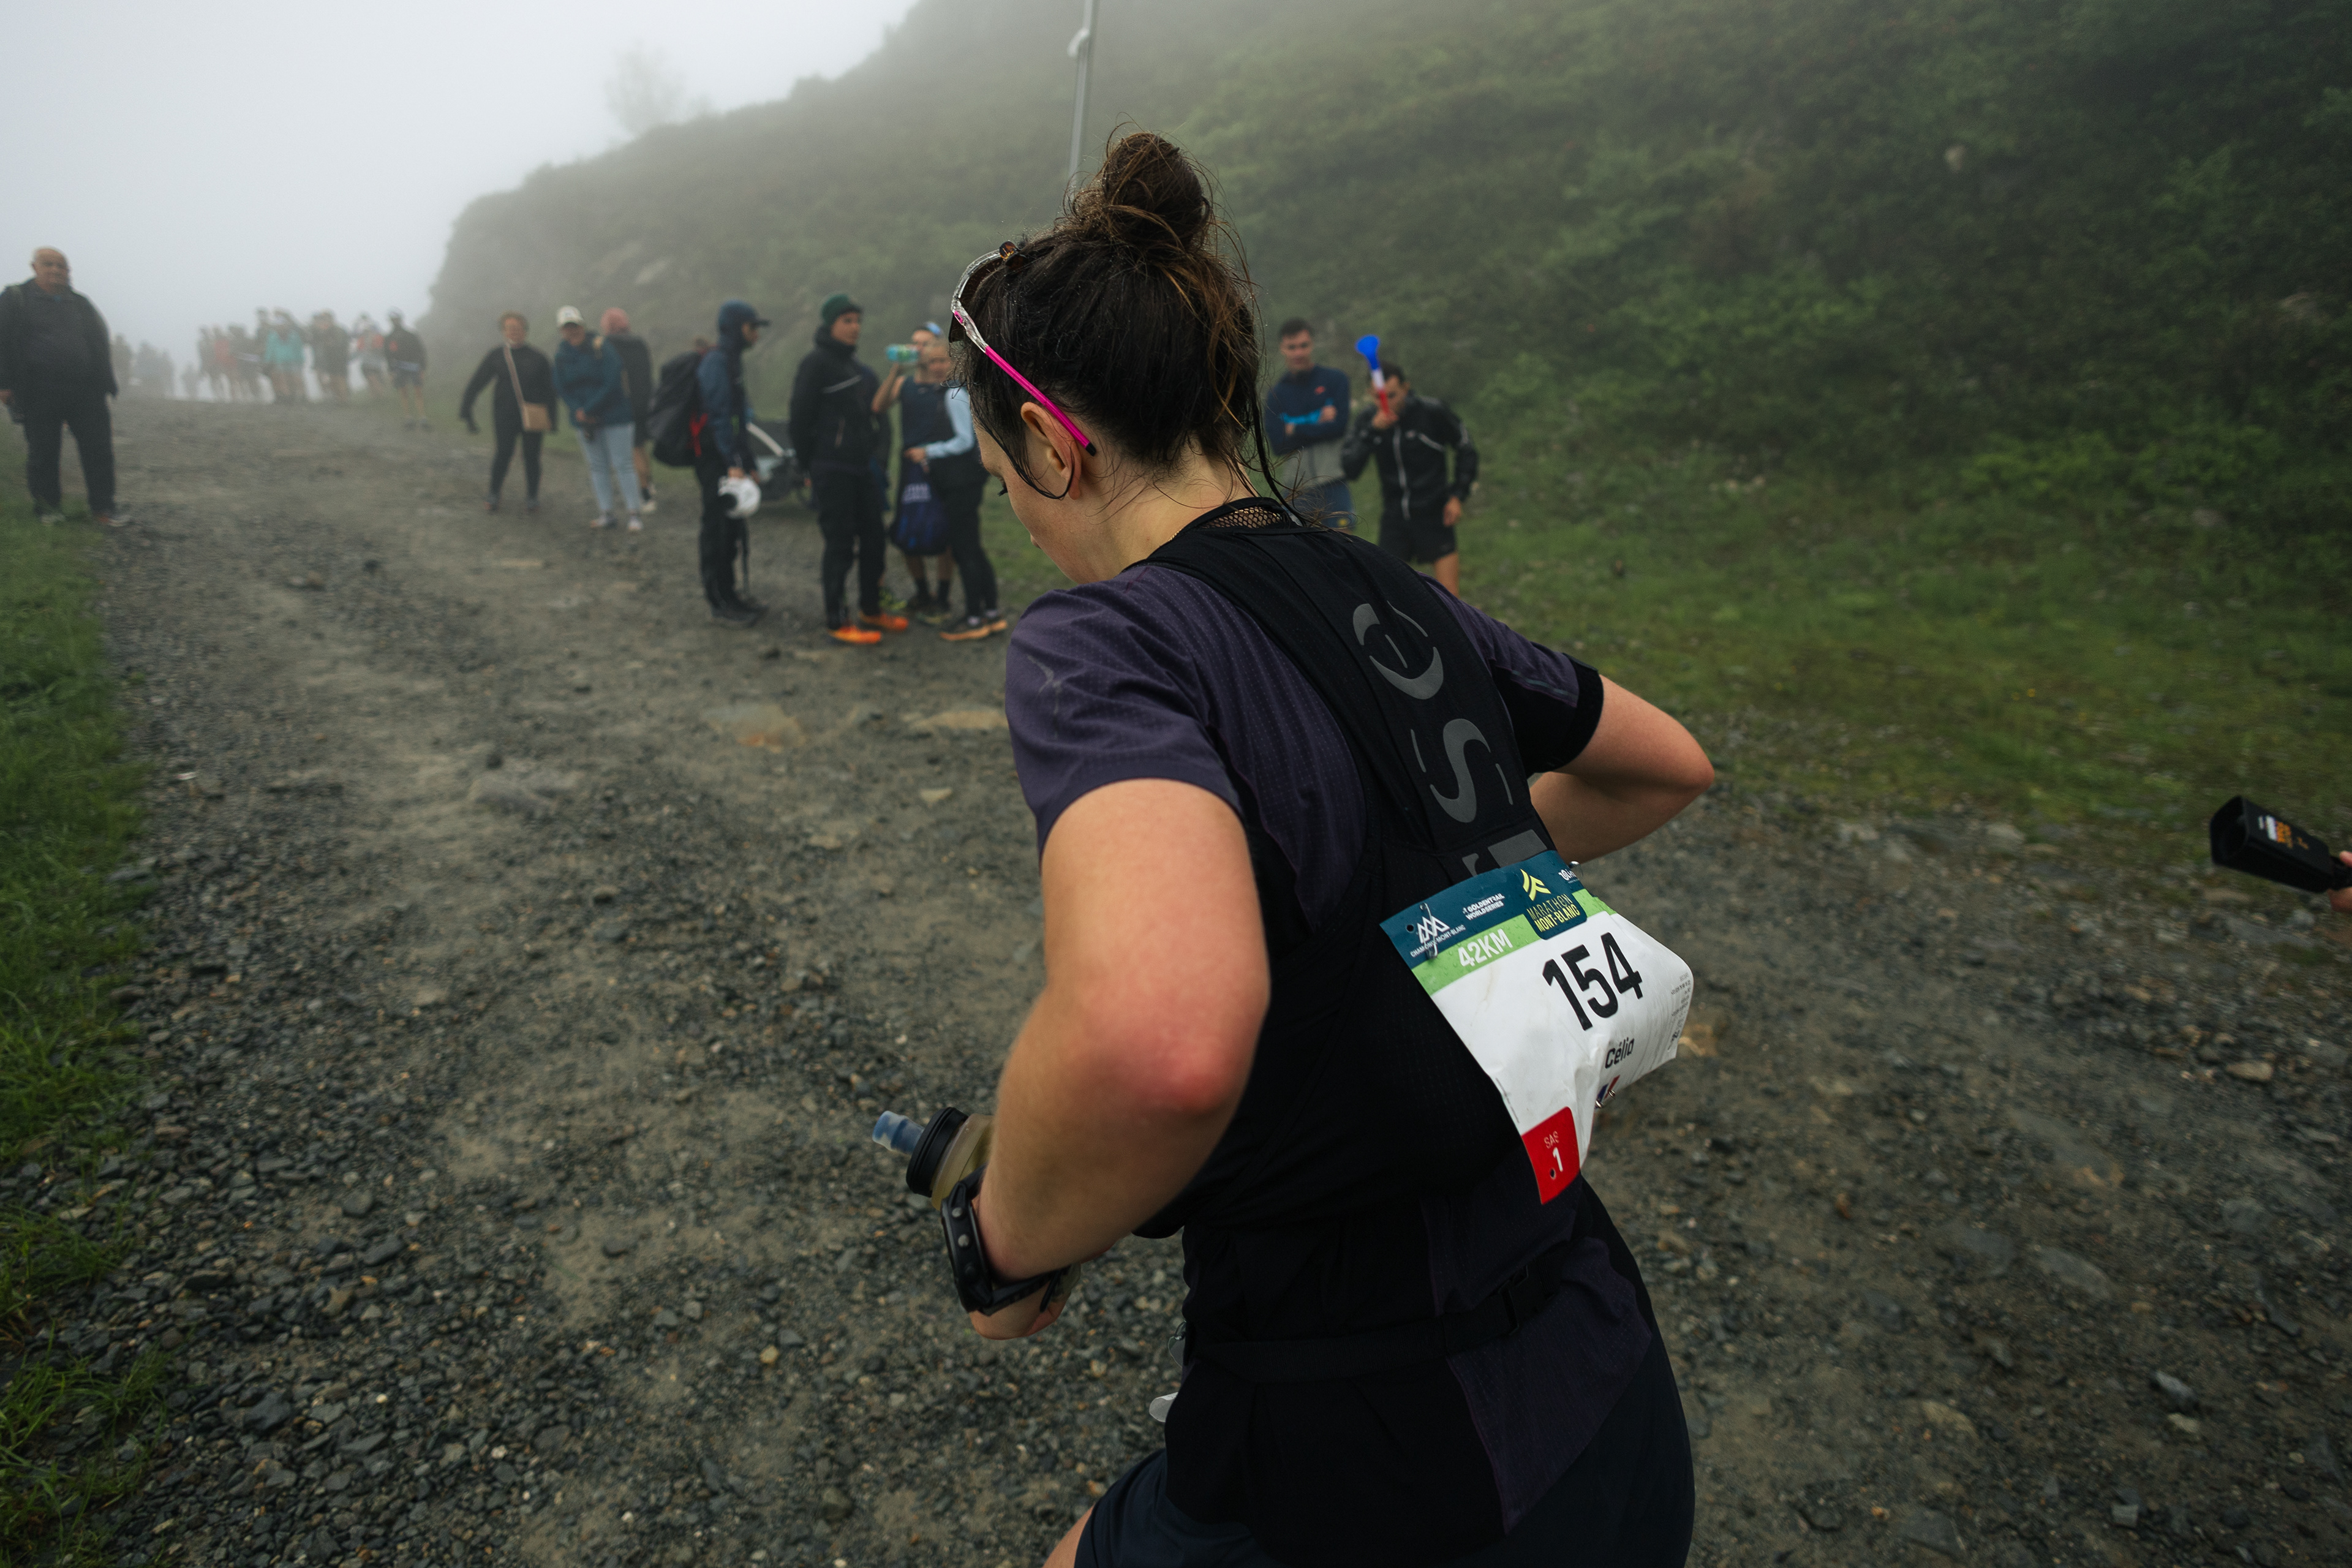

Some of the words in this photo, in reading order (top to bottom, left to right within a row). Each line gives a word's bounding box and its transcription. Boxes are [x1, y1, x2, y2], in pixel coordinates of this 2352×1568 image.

[1526, 893, 1573, 921] MARATHON
[1534, 903, 1581, 932] MONT-BLANC
[1458, 928, 1513, 967] 42KM
[1542, 932, 1643, 1031] 154
[1605, 1037, 1635, 1069] Célia
[1544, 1131, 1559, 1149] SAS
[1552, 1147, 1564, 1172] 1
